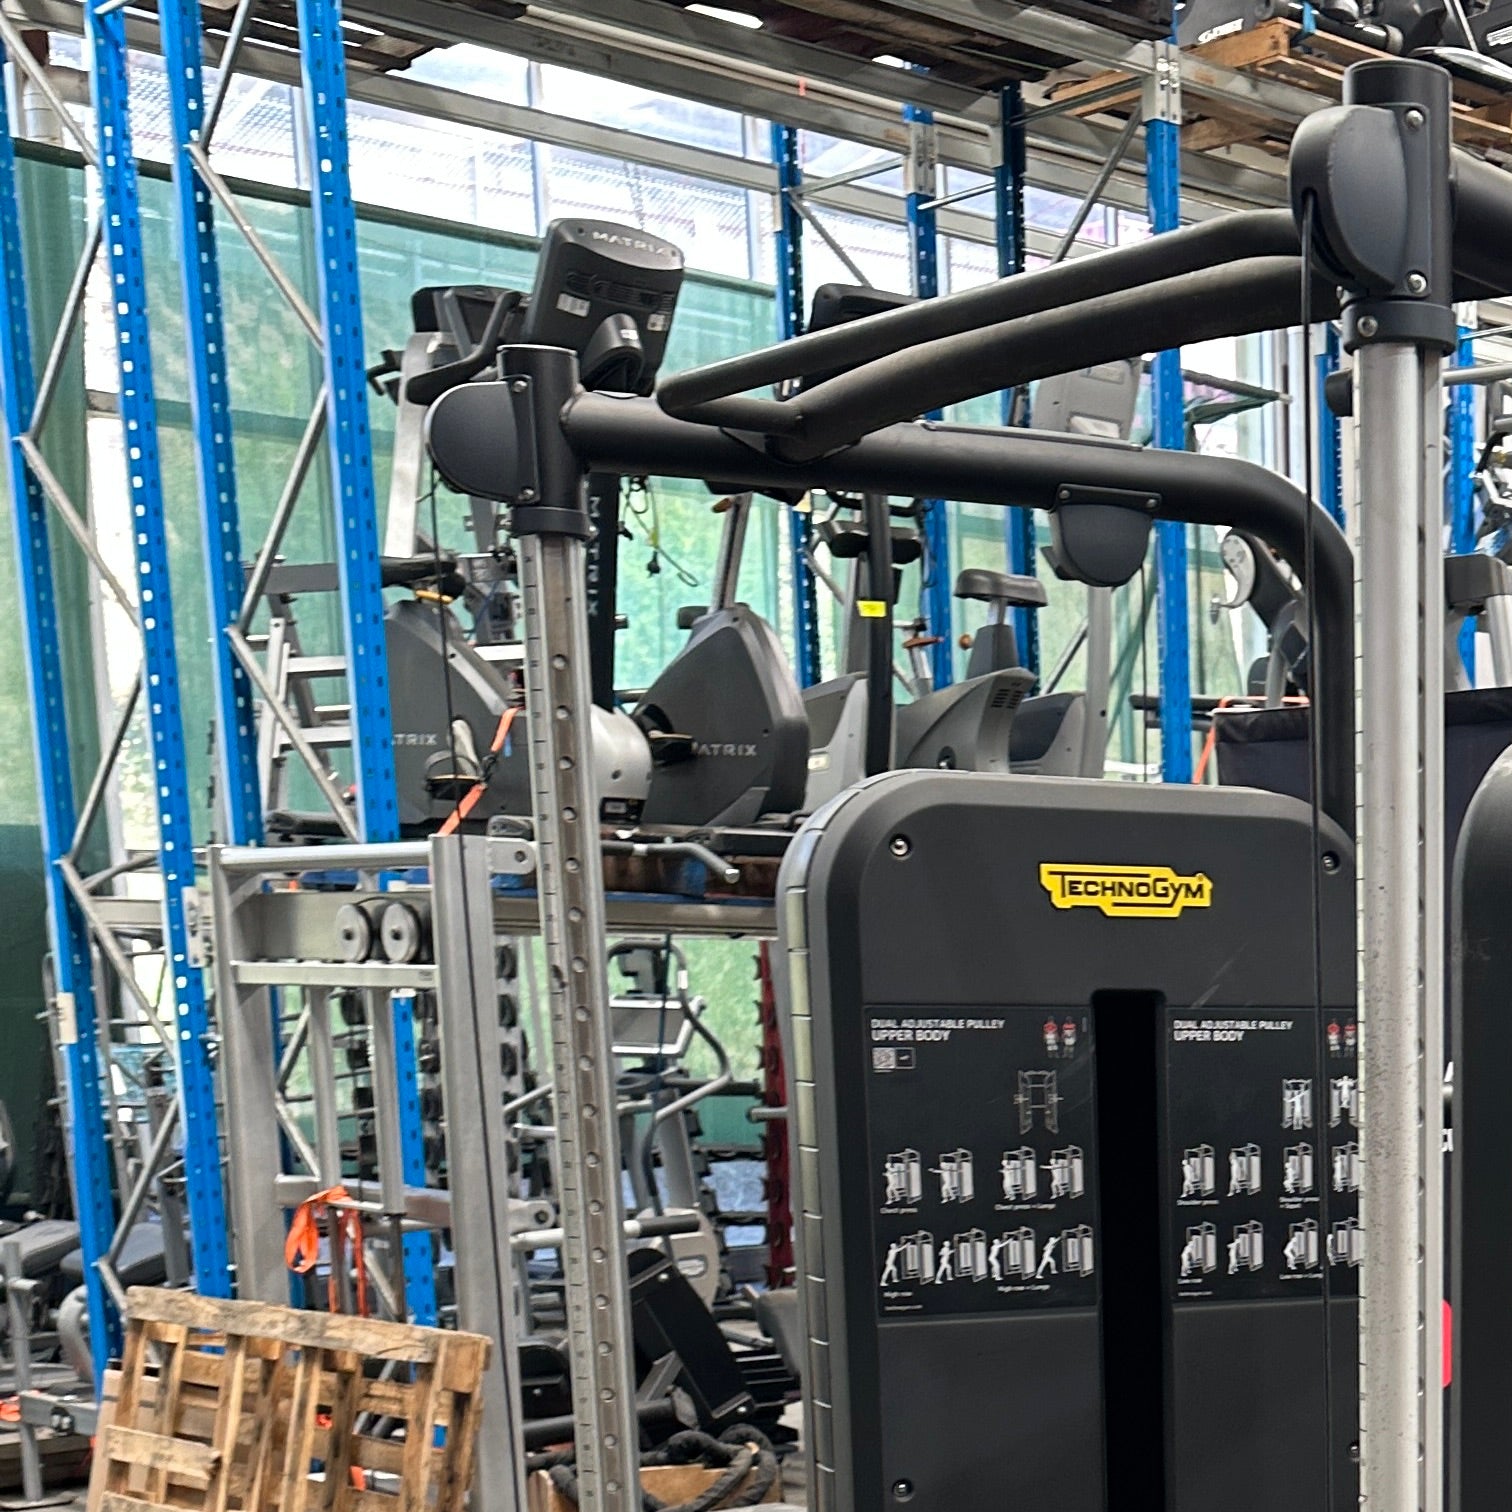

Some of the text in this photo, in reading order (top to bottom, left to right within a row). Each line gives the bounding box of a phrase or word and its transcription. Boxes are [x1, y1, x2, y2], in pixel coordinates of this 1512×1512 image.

[587, 496, 601, 617] MTRIX
[871, 1018, 1006, 1030] DUAL ADJUSTABLE PULLEY
[1173, 1019, 1294, 1031] DUAL ADJUSTABLE PULLEY
[871, 1029, 952, 1042] UPPER BODY
[1173, 1030, 1246, 1042] UPPER BODY
